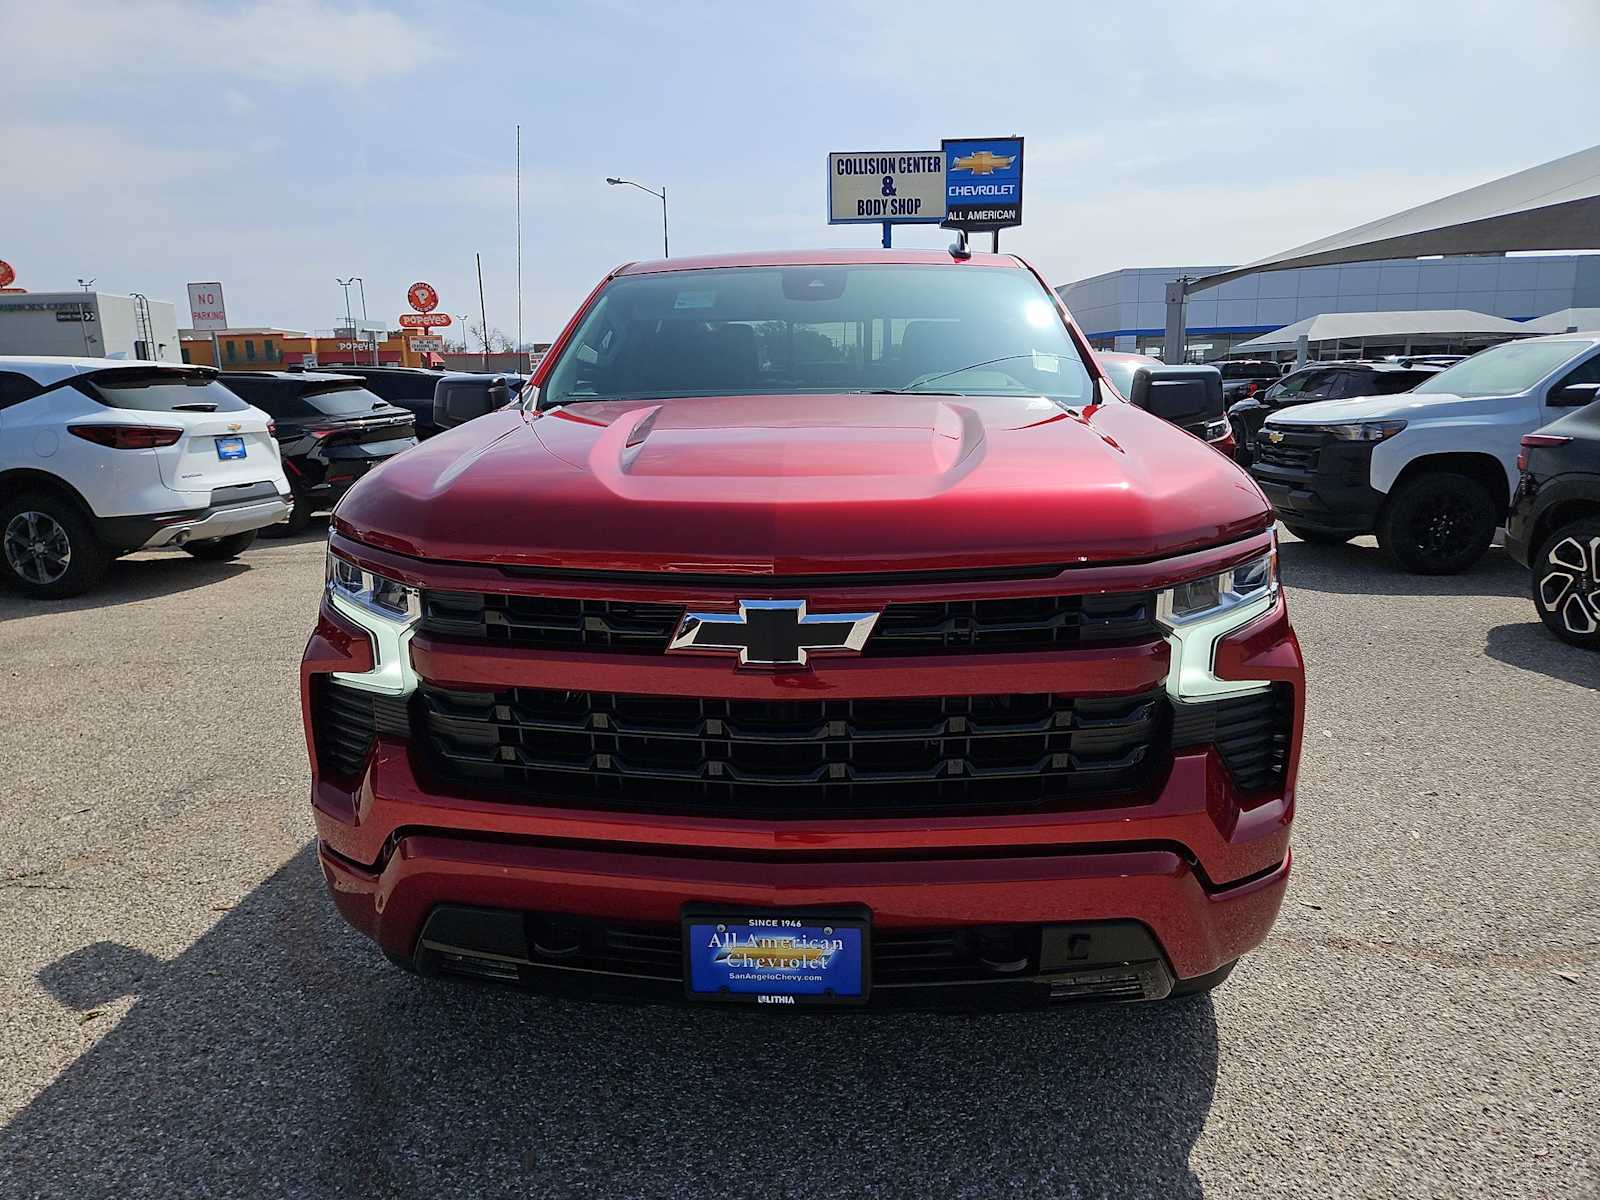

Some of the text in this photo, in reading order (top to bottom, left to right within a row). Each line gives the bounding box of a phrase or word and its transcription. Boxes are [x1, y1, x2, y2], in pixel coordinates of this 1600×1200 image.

[837, 156, 941, 175] COLLISION CENTER
[881, 175, 897, 197] &
[948, 184, 1015, 197] CHEVROLET
[857, 198, 922, 216] BODY SHOP
[947, 209, 1016, 221] ALL AMERICAN
[197, 293, 215, 305] NO
[191, 311, 225, 321] PARKING
[748, 919, 802, 928] SINCE 1946
[707, 932, 844, 950] All American
[727, 953, 828, 969] Chevrolet
[729, 972, 822, 982] SanAngeloChevy.com
